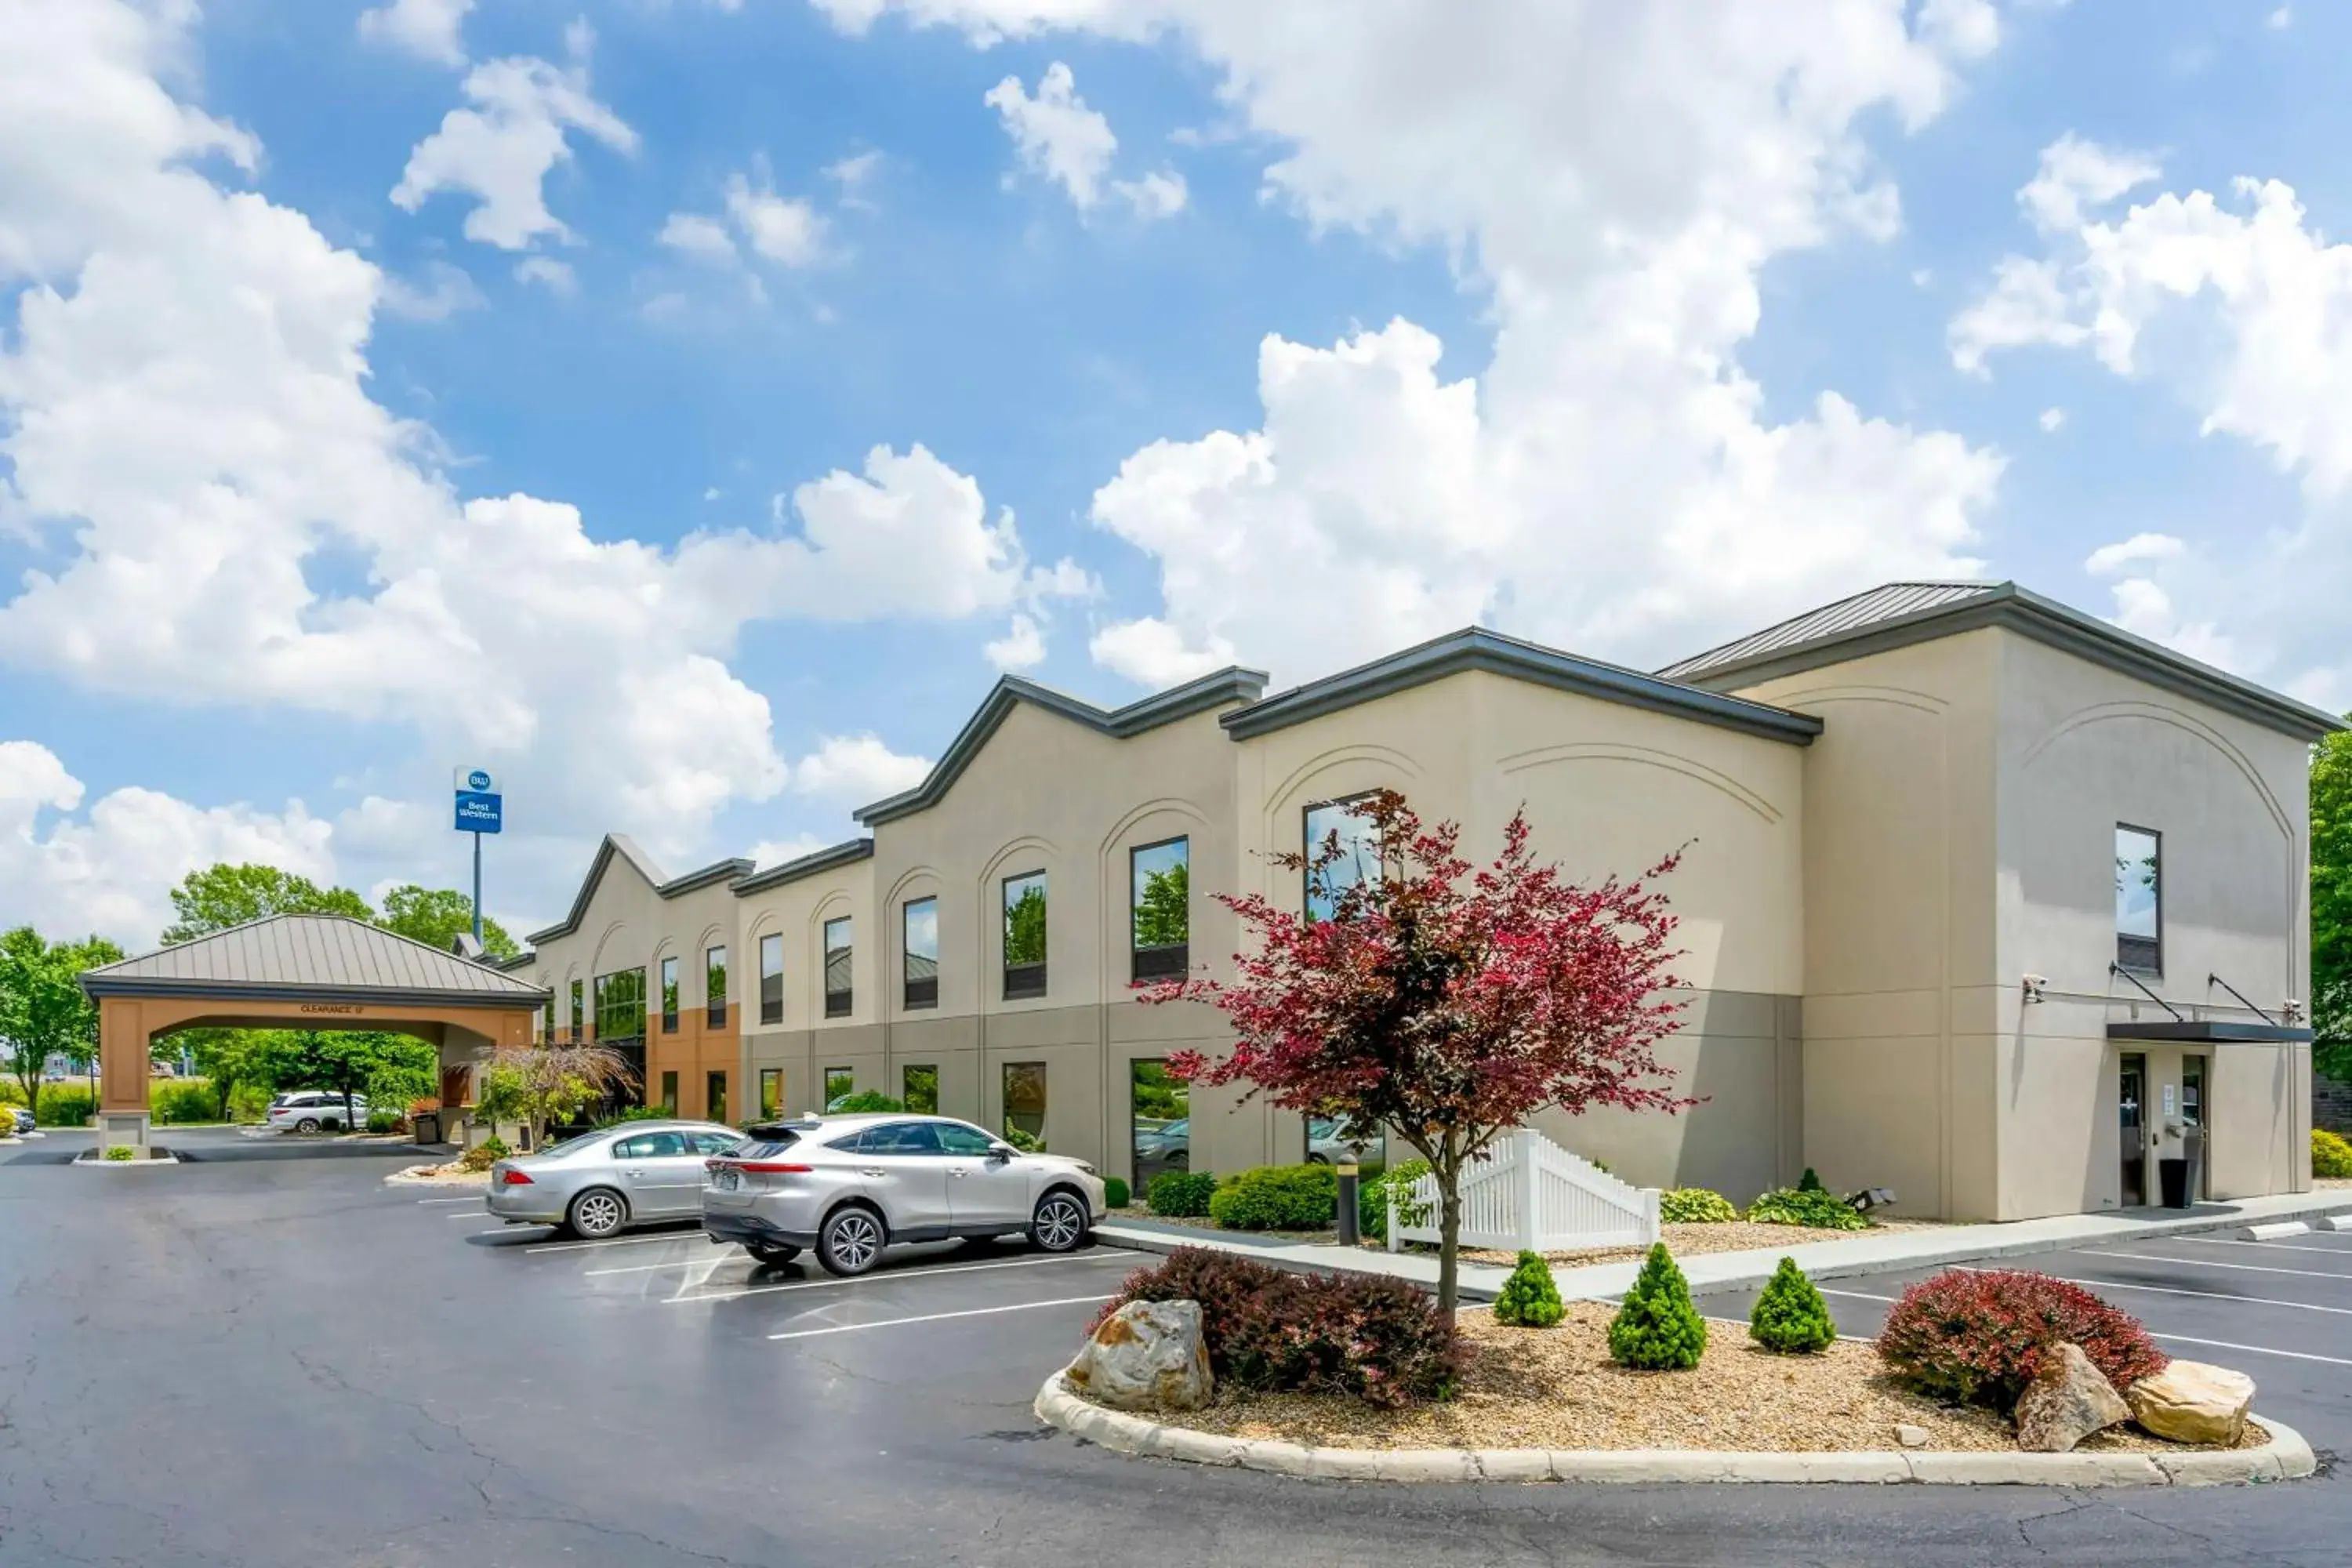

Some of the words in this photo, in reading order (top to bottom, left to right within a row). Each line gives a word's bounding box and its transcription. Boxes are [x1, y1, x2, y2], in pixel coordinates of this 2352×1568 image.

[468, 801, 489, 811] Best
[459, 808, 498, 819] Western
[300, 1004, 351, 1013] CLEARANCE
